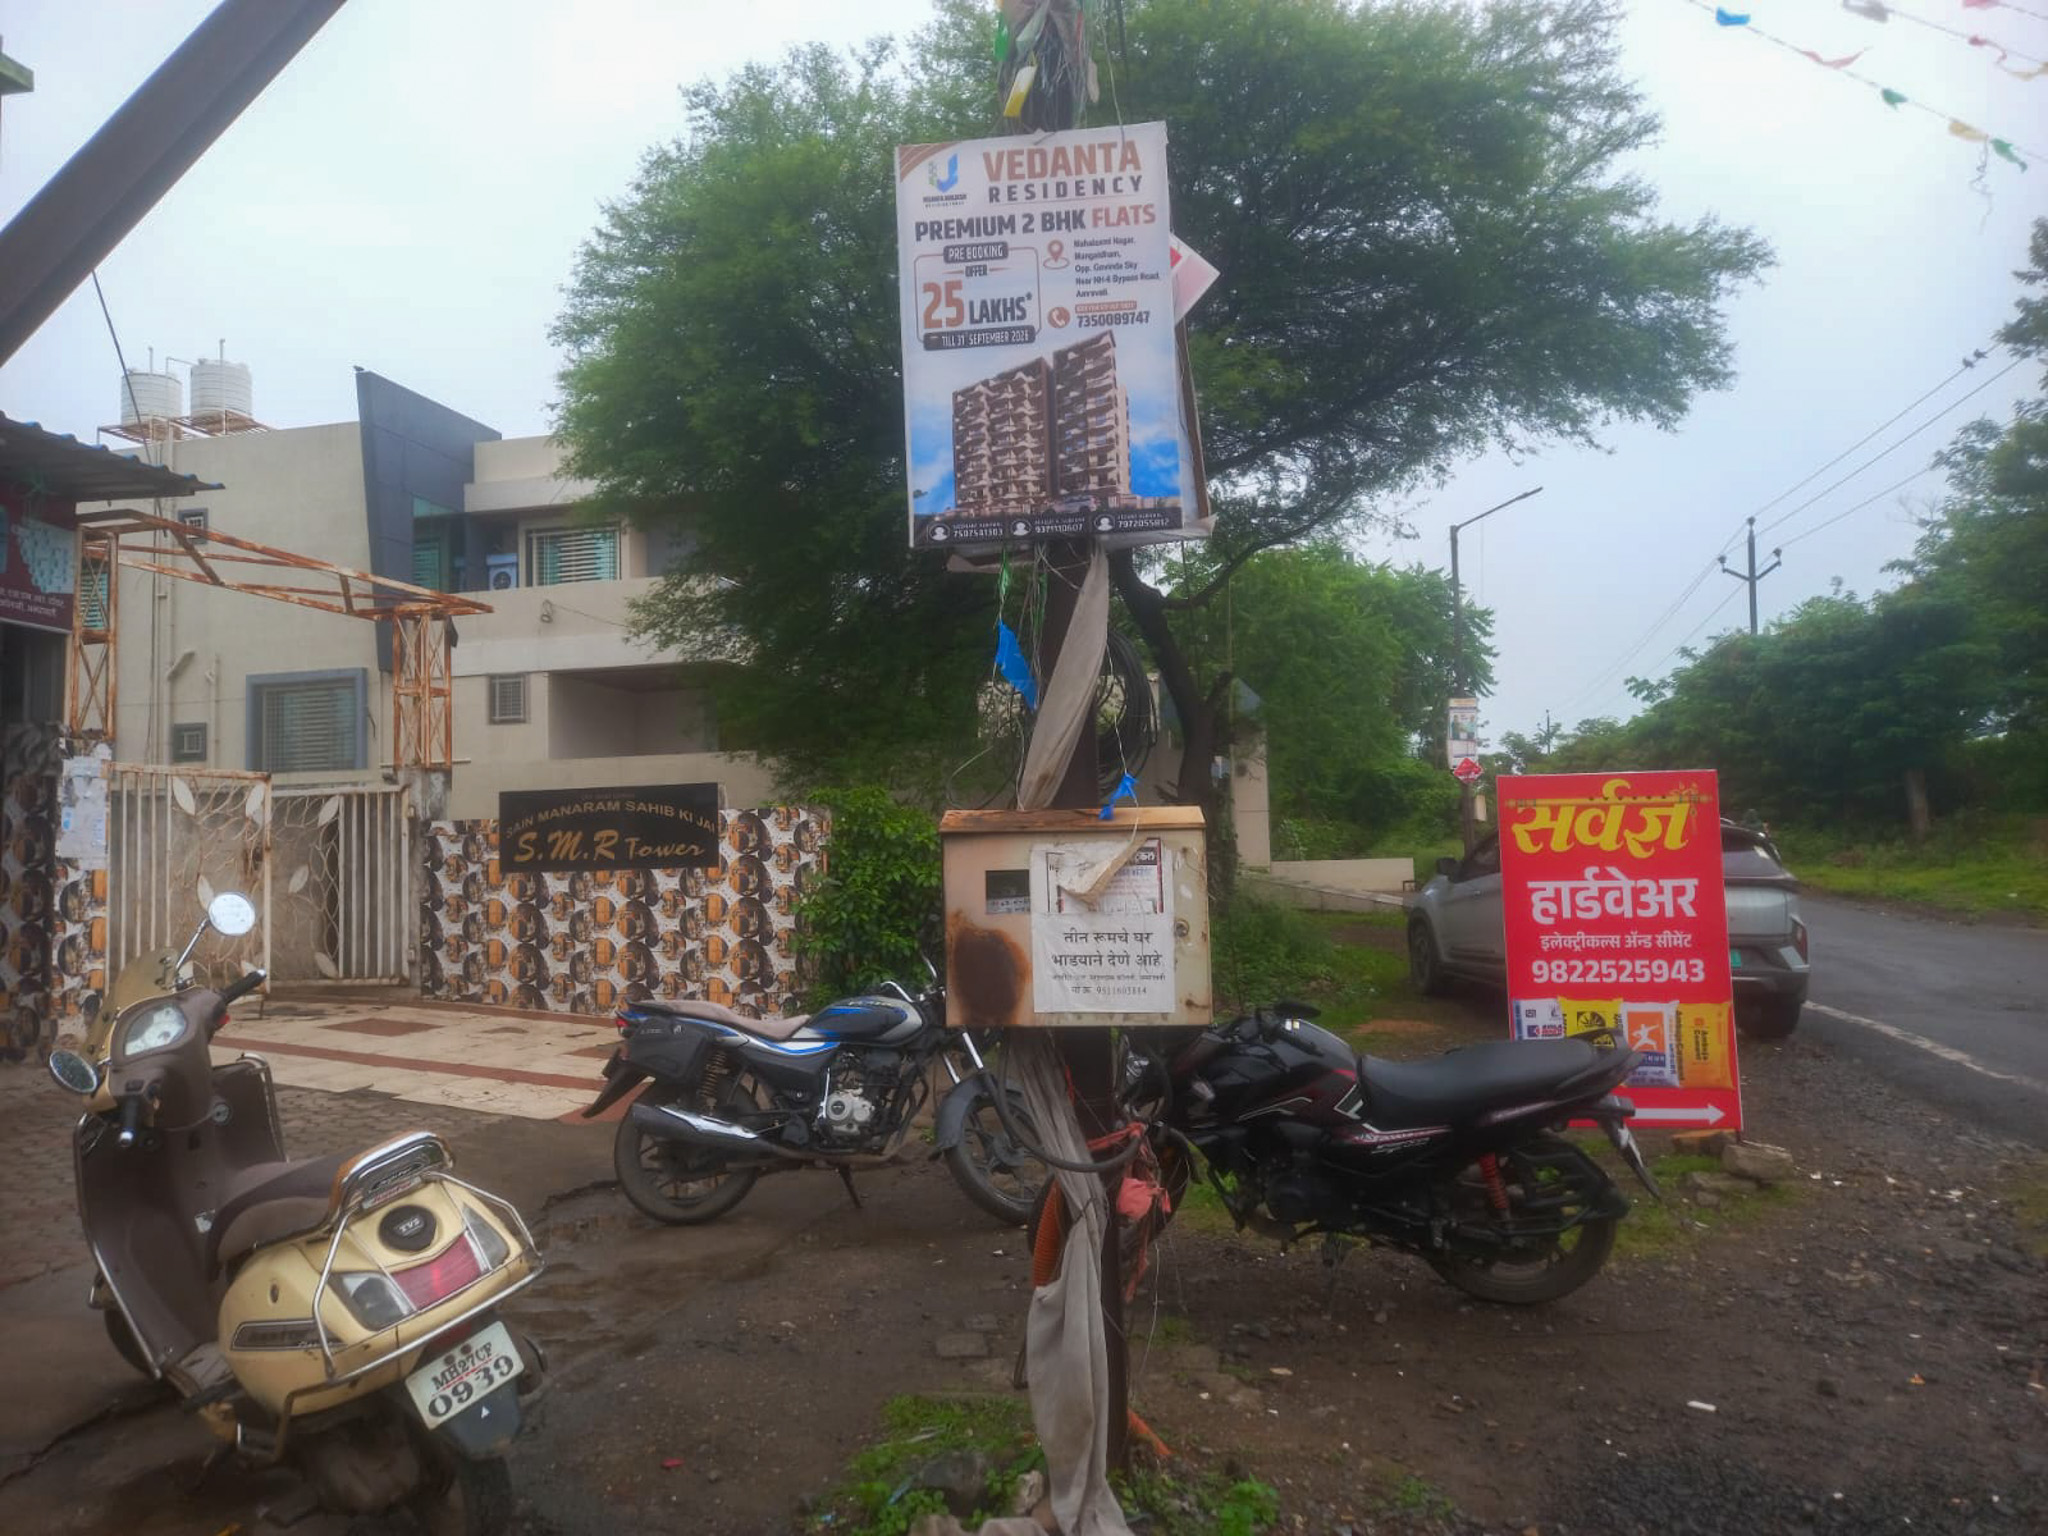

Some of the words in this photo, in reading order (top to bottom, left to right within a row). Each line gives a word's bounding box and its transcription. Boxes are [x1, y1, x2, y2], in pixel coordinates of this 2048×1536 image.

[983, 140, 1141, 181] VEDANTA
[988, 175, 1143, 203] RESIDENCY
[915, 214, 1016, 241] PREMIUM
[1021, 213, 1035, 234] 2
[1041, 209, 1086, 232] BHK
[1091, 204, 1156, 228] FLATS
[948, 247, 964, 260] PRE
[966, 245, 1003, 259] BOOKING
[965, 264, 988, 277] OFFER
[922, 280, 964, 329] 25
[1077, 310, 1150, 328] 7350089747
[942, 336, 955, 347] TILL
[969, 332, 1009, 346] SEPTEMBER
[506, 816, 534, 839] SAIN
[538, 801, 621, 823] MANARAM
[624, 801, 676, 817] SAHIB
[679, 809, 694, 823] KI
[696, 816, 716, 834] JAI
[624, 837, 705, 860] Tower
[1527, 866, 1698, 925] हार्डवेअर
[1063, 928, 1089, 944] तीन
[1093, 928, 1130, 945] रूमचे
[1133, 931, 1153, 944] घर
[1655, 930, 1692, 949] सीमेंट
[1107, 950, 1130, 967] देणे
[1134, 950, 1163, 967] आहे
[1531, 959, 1706, 984] 9822525943
[399, 1218, 420, 1233] TVS
[427, 1355, 515, 1418] 0939
